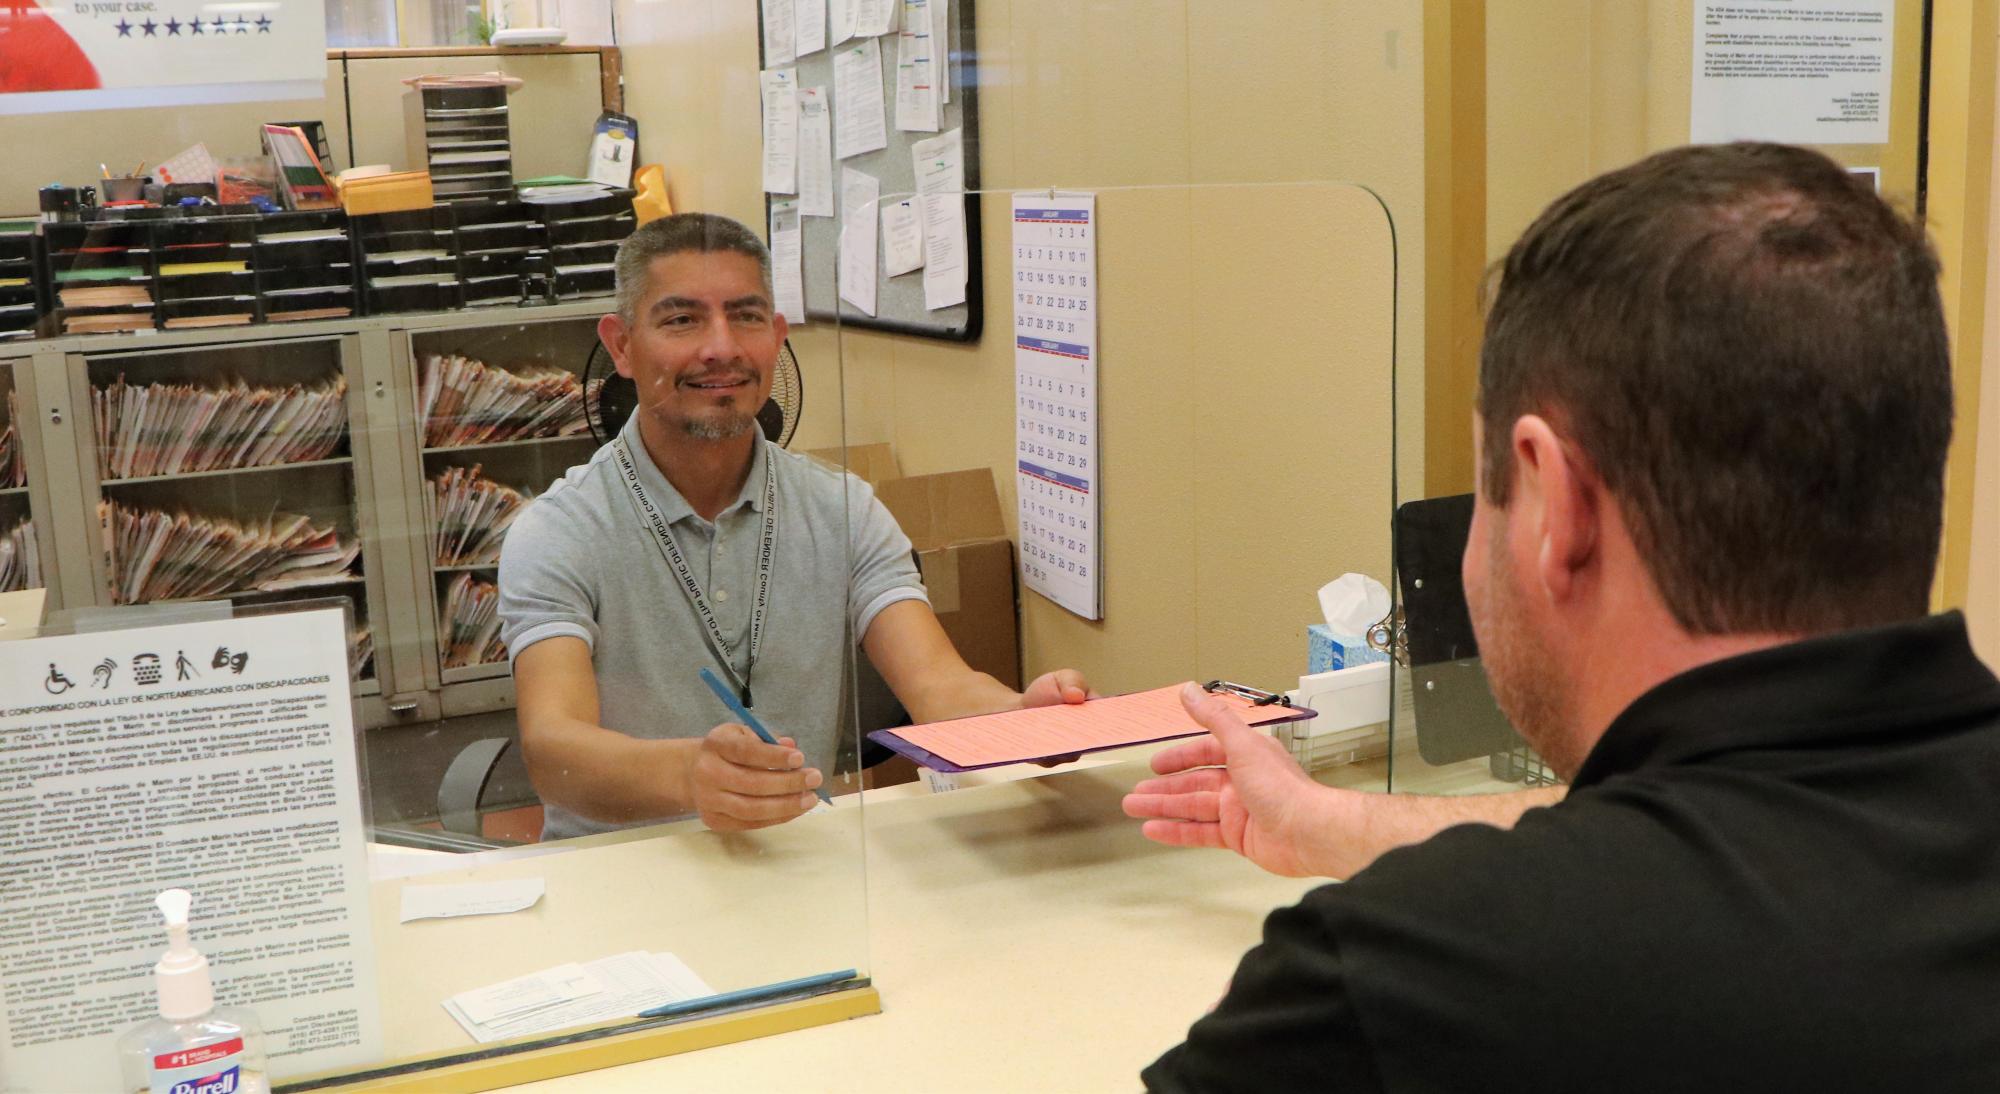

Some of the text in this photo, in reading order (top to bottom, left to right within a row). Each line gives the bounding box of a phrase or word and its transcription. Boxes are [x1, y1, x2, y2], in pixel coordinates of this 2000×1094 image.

[74, 2, 157, 19] to your case.
[1068, 252, 1076, 262] 10
[1079, 252, 1086, 262] 11
[1018, 272, 1024, 282] 12
[1037, 272, 1044, 283] 14
[1047, 273, 1055, 284] 15
[1057, 274, 1065, 286] 16
[1068, 276, 1076, 286] 17
[1079, 276, 1087, 288] 18
[1036, 295, 1043, 306] 21
[1046, 297, 1054, 308] 22
[1057, 298, 1065, 308] 23
[1067, 299, 1076, 310] 24
[1078, 301, 1088, 312] 25
[1018, 316, 1075, 334] 26 27 28 29 30 31
[1047, 404, 1054, 414] 12
[1057, 406, 1065, 416] 13
[1068, 408, 1076, 418] 14
[1079, 412, 1087, 422] 15
[1047, 426, 1054, 437] 19
[1057, 429, 1065, 440] 20
[1067, 431, 1075, 442] 21
[1079, 434, 1088, 445] 22
[1037, 446, 1044, 457] 25
[1047, 448, 1055, 459] 26
[1056, 451, 1065, 462] 27
[1067, 454, 1076, 466] 28
[1078, 456, 1087, 469] 29
[1058, 512, 1065, 524] 12
[1079, 520, 1087, 531] 14
[1048, 532, 1086, 554] 18 19 20 21
[1048, 554, 1055, 564] 25
[1058, 558, 1065, 568] 26
[1068, 562, 1076, 572] 27
[1078, 566, 1087, 576] 28
[8, 702, 75, 717] CONFORMIDAD
[77, 700, 97, 709] CON
[98, 698, 110, 707] LA
[112, 696, 129, 705] LEY
[131, 695, 143, 703] DE
[145, 685, 233, 702] NORTEAMERICANOS
[234, 683, 253, 692] CON
[255, 675, 330, 690] DISCAPACIDADES
[64, 718, 100, 730] requisitos
[165, 710, 178, 719] Ley
[192, 702, 252, 714] Norteamericanos
[270, 694, 326, 707] Discapacidades
[66, 727, 100, 736] Condado
[123, 722, 144, 730] Marin
[230, 710, 262, 720] personas
[34, 740, 55, 749] sobre
[67, 737, 84, 745] base
[106, 730, 154, 742] discapacidad
[220, 719, 257, 730] programas
[19, 753, 54, 763] Condado
[68, 750, 90, 758] Marin
[337, 1008, 357, 1016] Marin
[171, 1053, 187, 1065] #1
